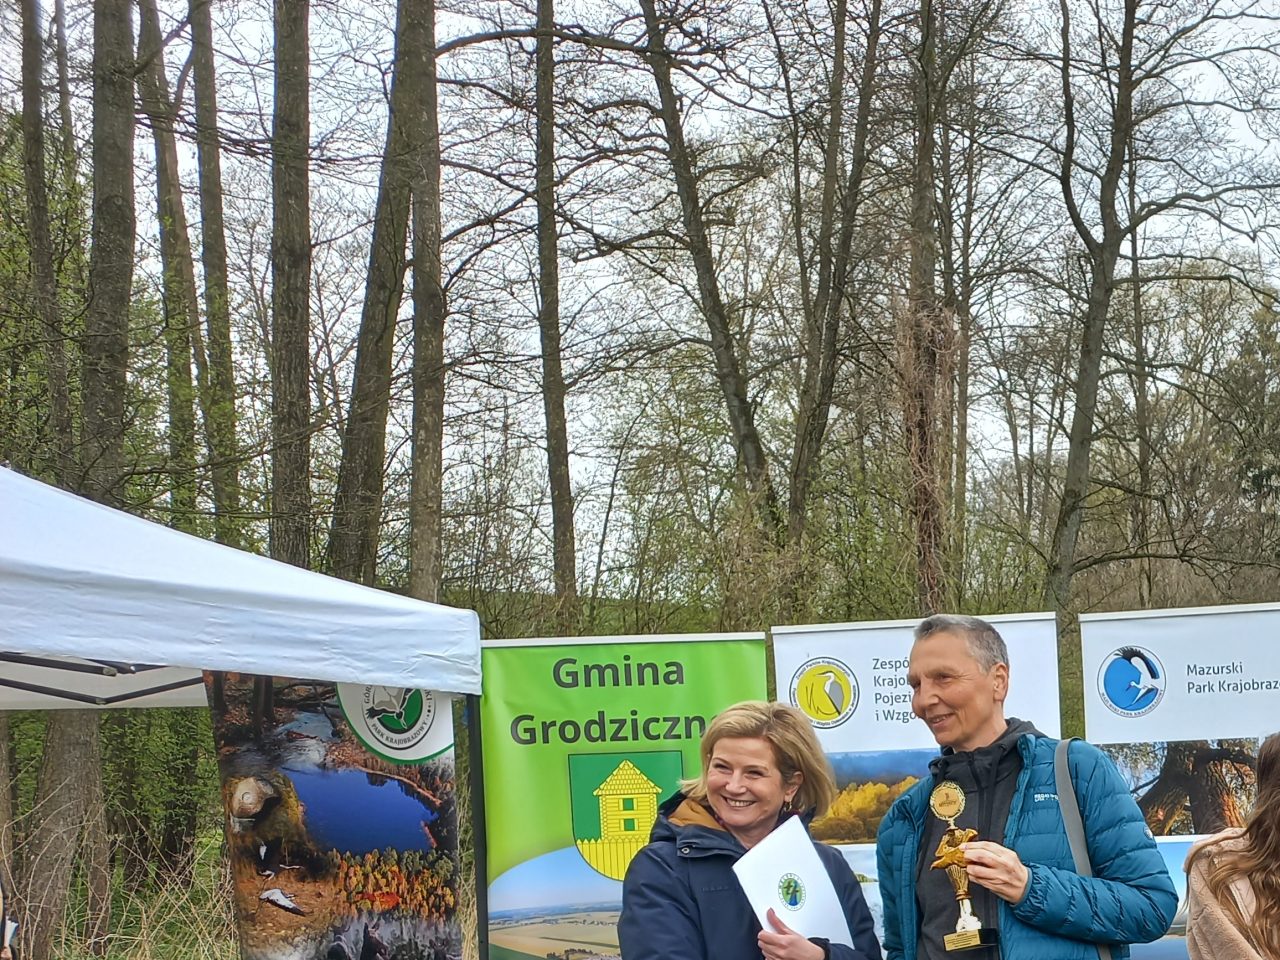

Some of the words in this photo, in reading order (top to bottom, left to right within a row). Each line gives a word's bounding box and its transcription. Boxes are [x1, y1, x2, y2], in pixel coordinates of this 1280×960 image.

[553, 655, 684, 688] Gmina
[1187, 662, 1243, 676] Mazurski
[1187, 681, 1215, 694] Park
[875, 709, 879, 721] i
[371, 723, 384, 739] PARK
[385, 721, 428, 746] KRAJOBRAZOWY
[510, 709, 718, 745] Grodziczn
